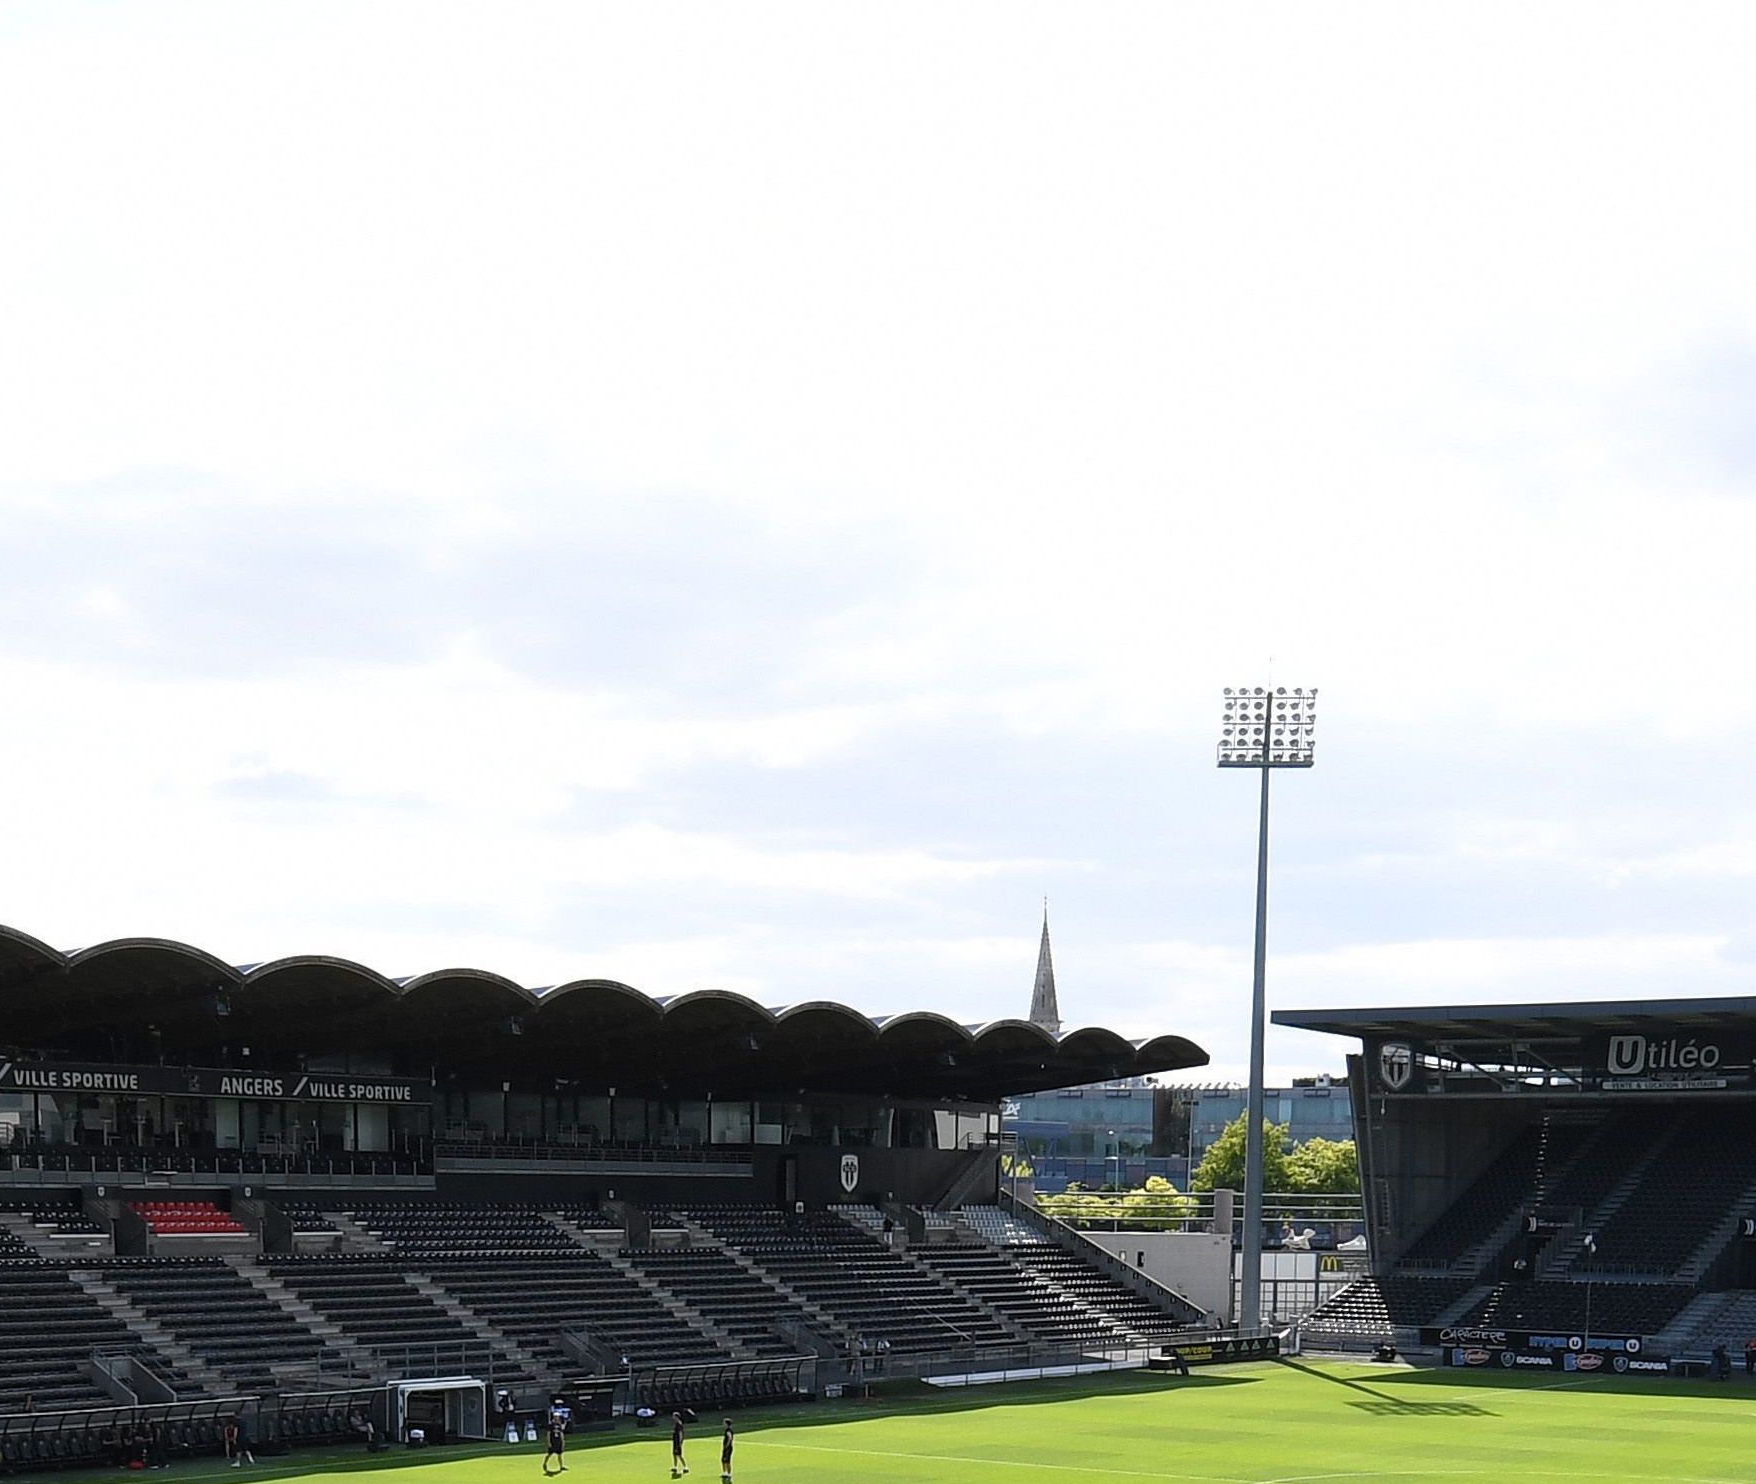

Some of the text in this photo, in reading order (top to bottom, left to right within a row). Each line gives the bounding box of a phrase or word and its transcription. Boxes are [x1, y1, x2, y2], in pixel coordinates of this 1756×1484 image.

[1608, 1036, 1720, 1074] Utiléo
[13, 1069, 57, 1087] VILLE
[62, 1072, 138, 1089] SPORTIVE
[221, 1077, 283, 1096] ANGERS
[310, 1083, 345, 1098] VILLE
[349, 1084, 411, 1100] SPORTIVE
[1516, 1355, 1553, 1365] SCANIA
[1629, 1361, 1668, 1371] SCANIA
